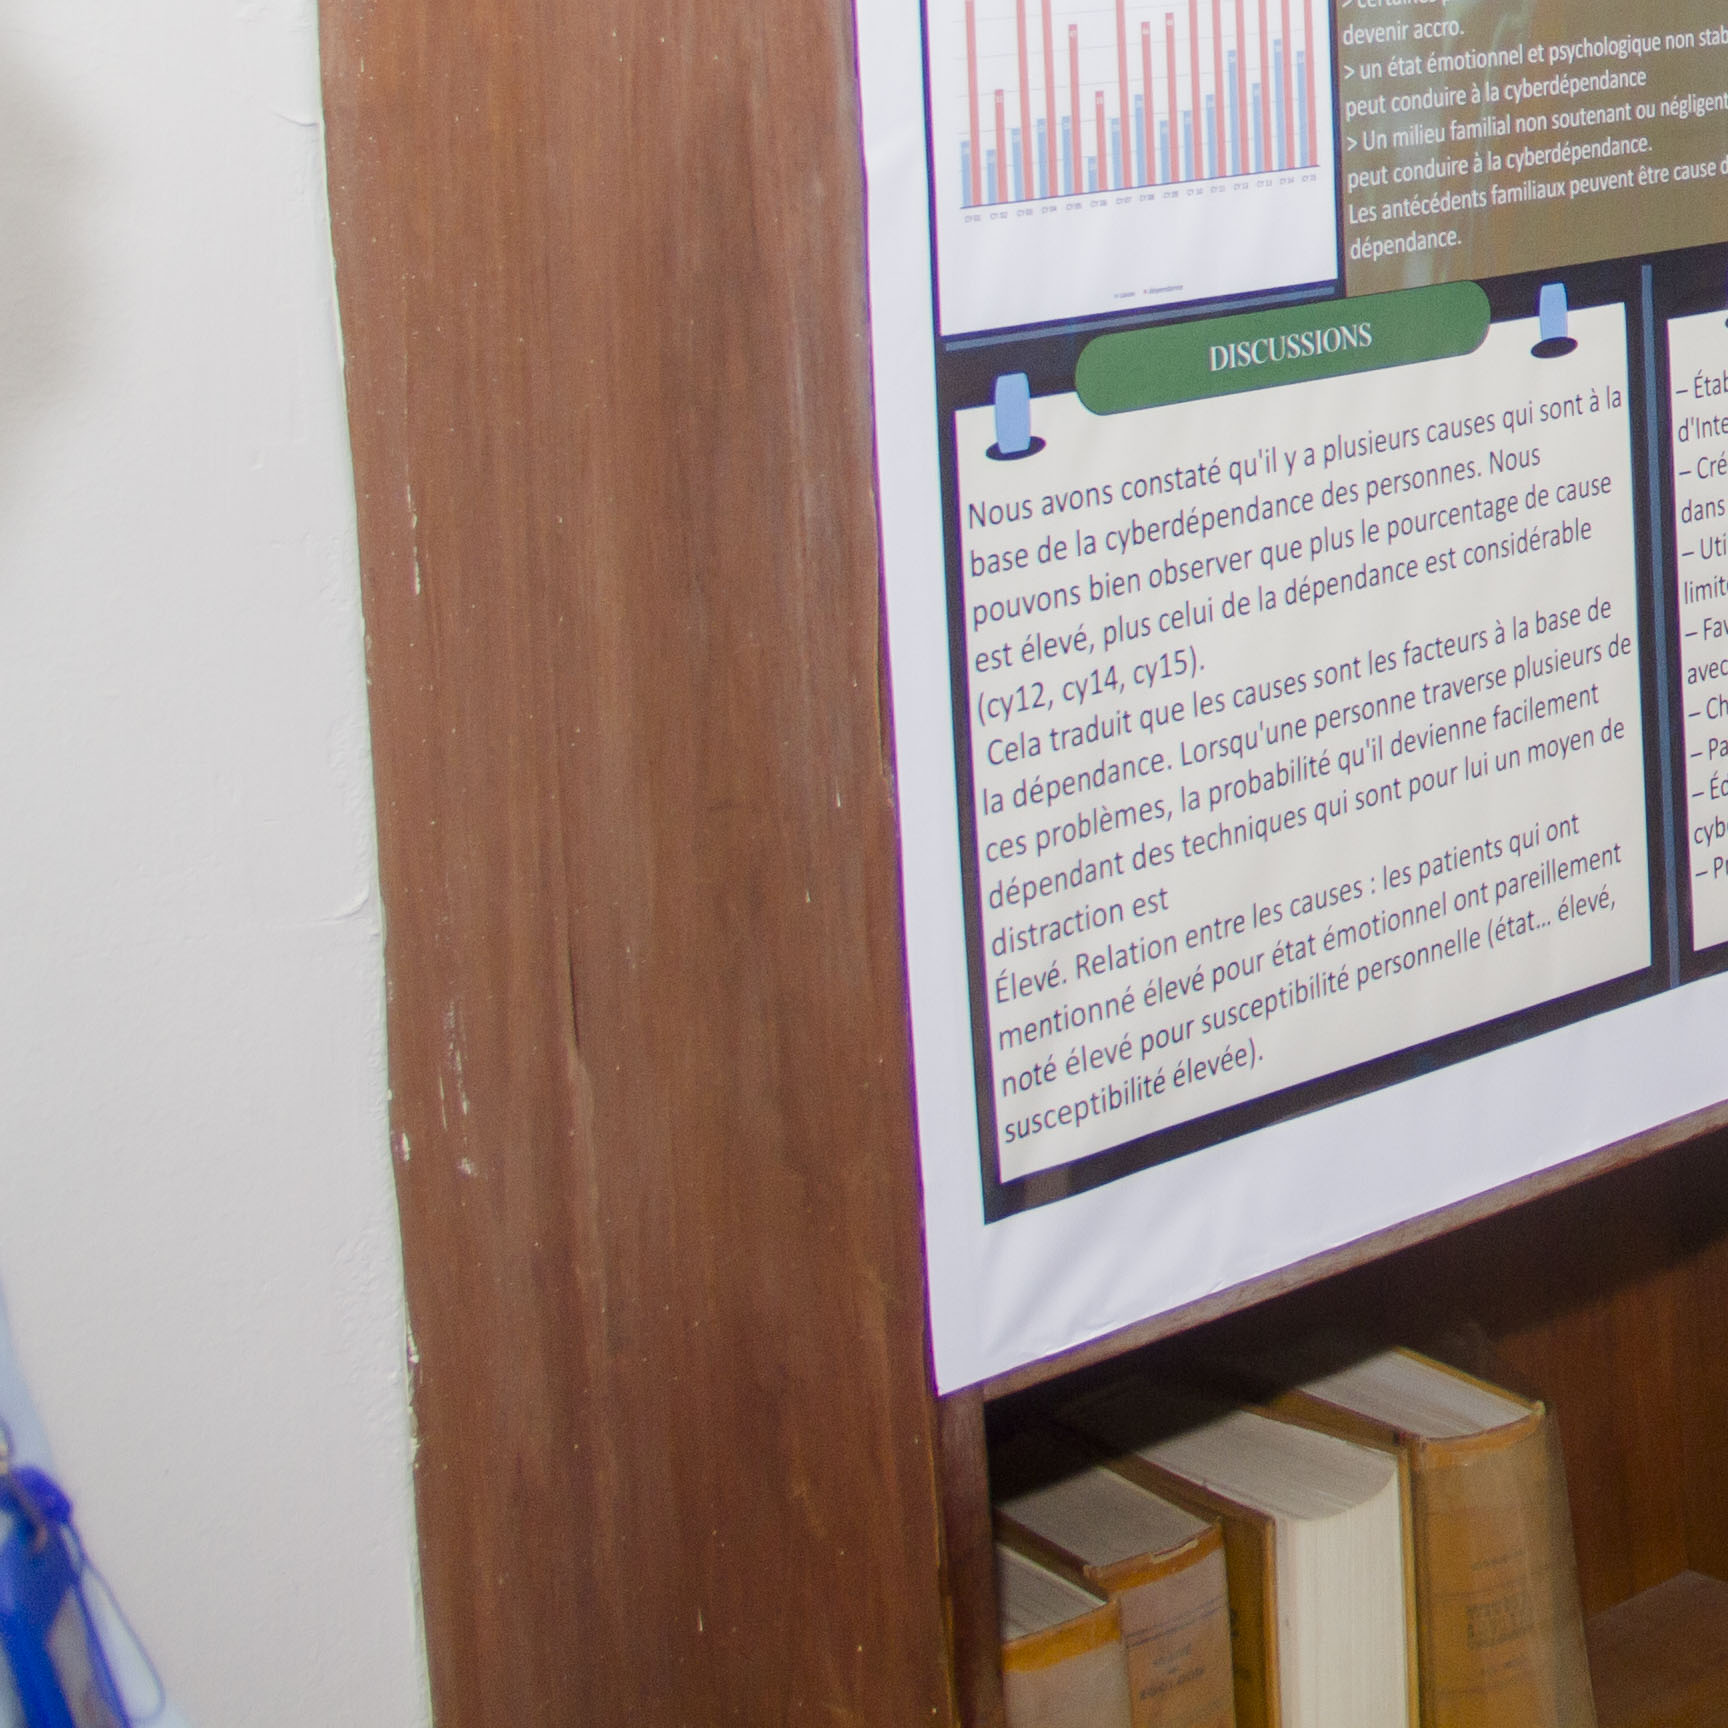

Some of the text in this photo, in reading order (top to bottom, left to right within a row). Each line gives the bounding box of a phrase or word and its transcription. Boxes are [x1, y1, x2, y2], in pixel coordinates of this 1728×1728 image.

[1210, 322, 1373, 372] DISCUSSIONS
[968, 385, 1622, 530] Nous avons constaté qu'il y a plusieurs causes qui sont à la
[977, 644, 1205, 727] (cy12, cy14, cy15).
